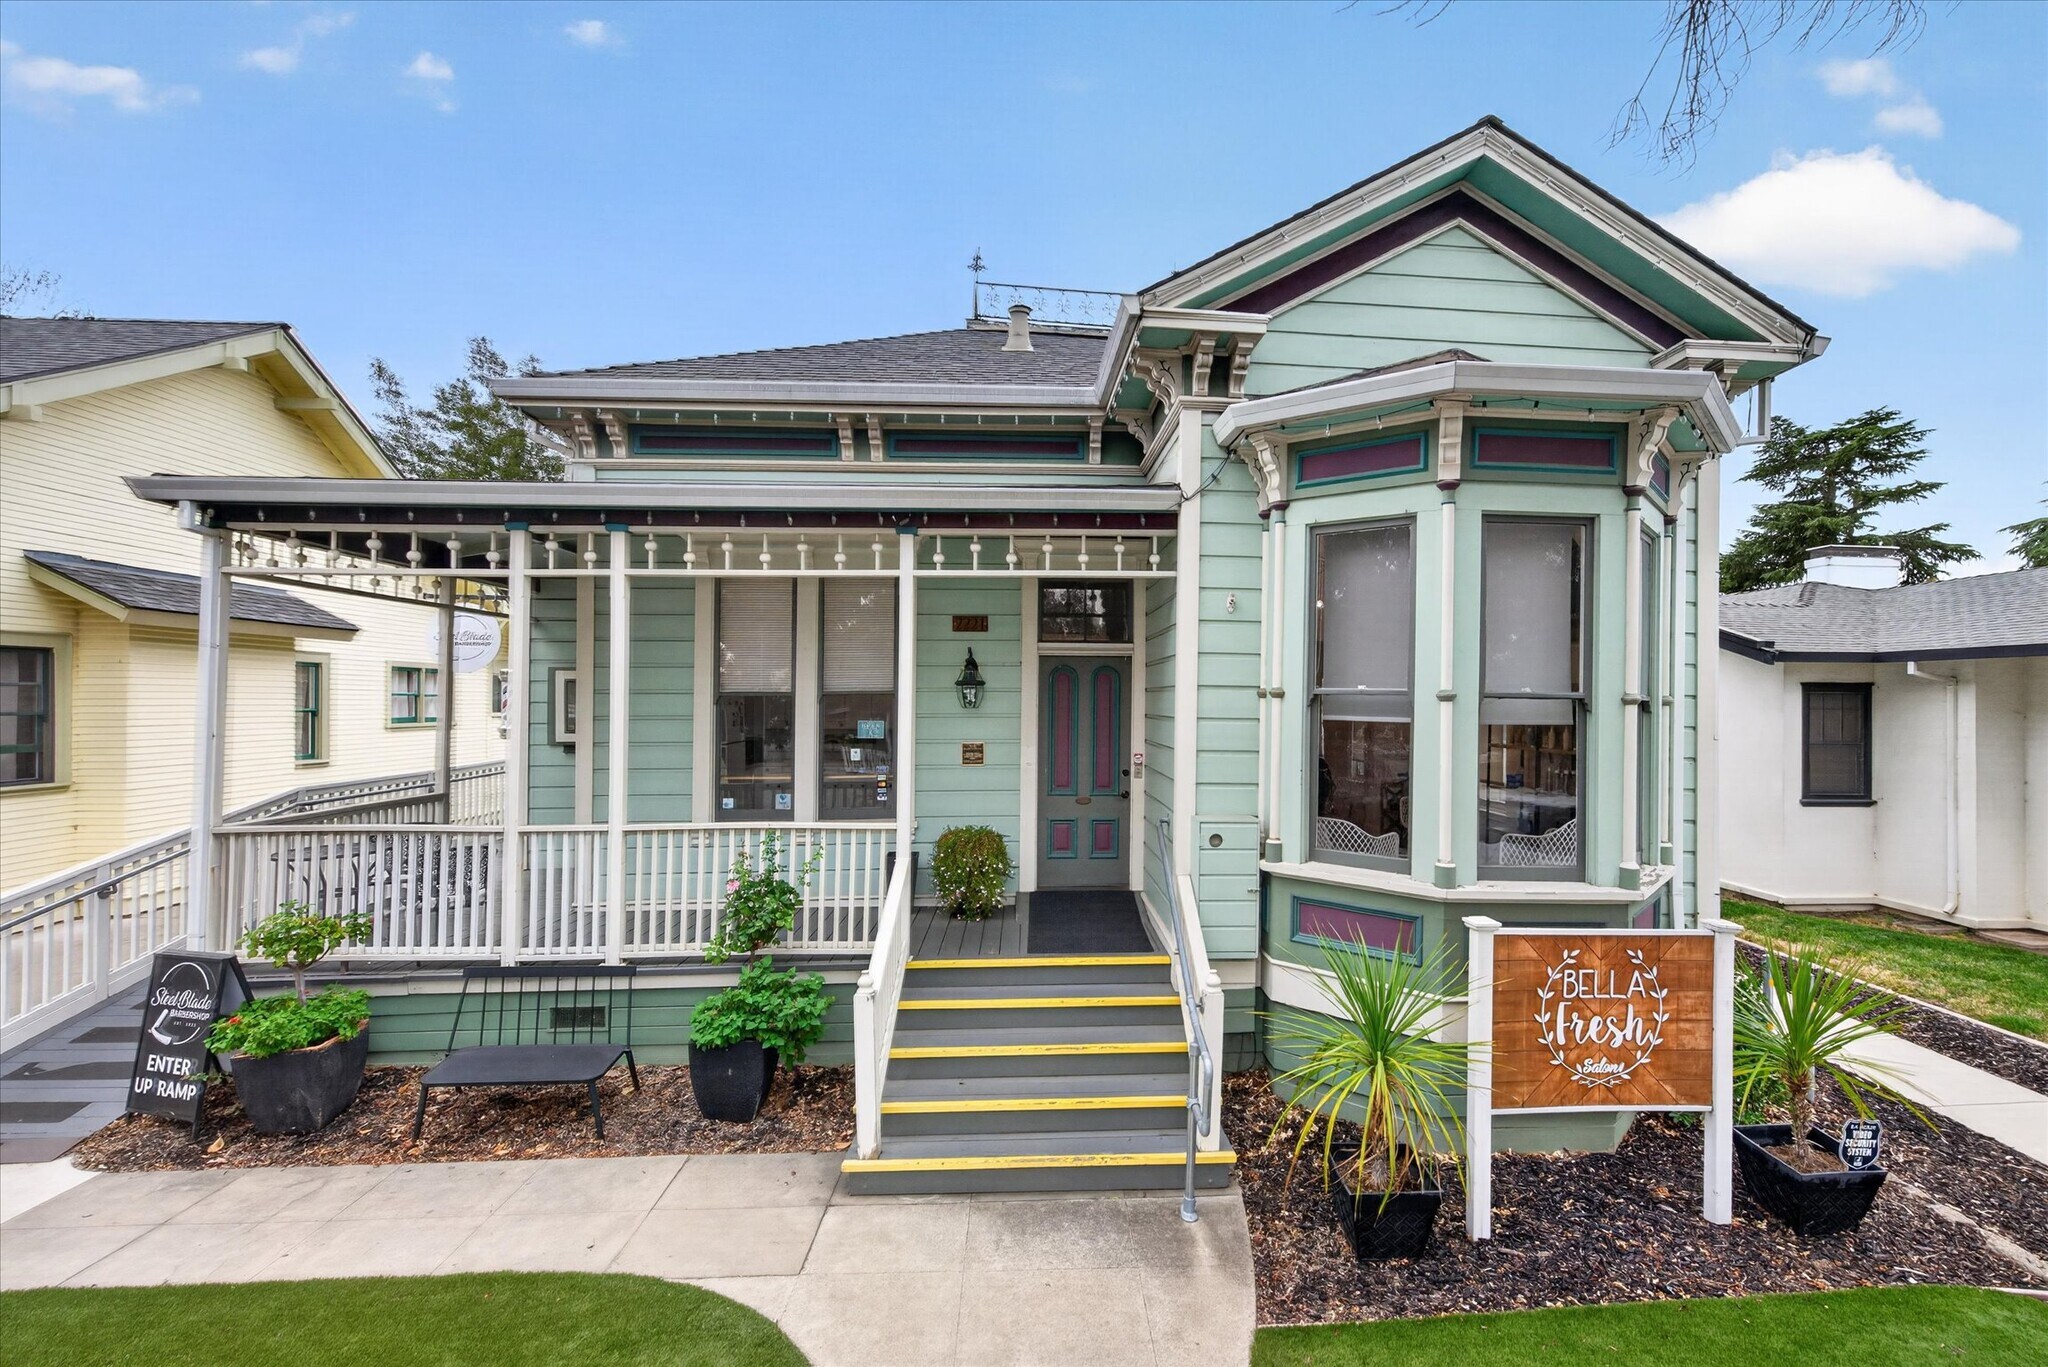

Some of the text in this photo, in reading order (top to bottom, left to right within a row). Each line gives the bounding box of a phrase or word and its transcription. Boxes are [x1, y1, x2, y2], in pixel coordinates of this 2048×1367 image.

[460, 630, 492, 641] Blade
[1562, 969, 1647, 999] BELLA
[151, 987, 212, 1010] Steel Blade
[170, 1009, 210, 1021] BARBERSHOP
[1556, 1001, 1653, 1048] Fresh
[146, 1054, 191, 1076] ENTER
[1583, 1057, 1622, 1073] Salon
[135, 1076, 197, 1101] UP RAMP
[1845, 1139, 1876, 1147] SECURITY
[1852, 1131, 1872, 1139] VIDEO
[1847, 1148, 1871, 1156] SYSTEM
